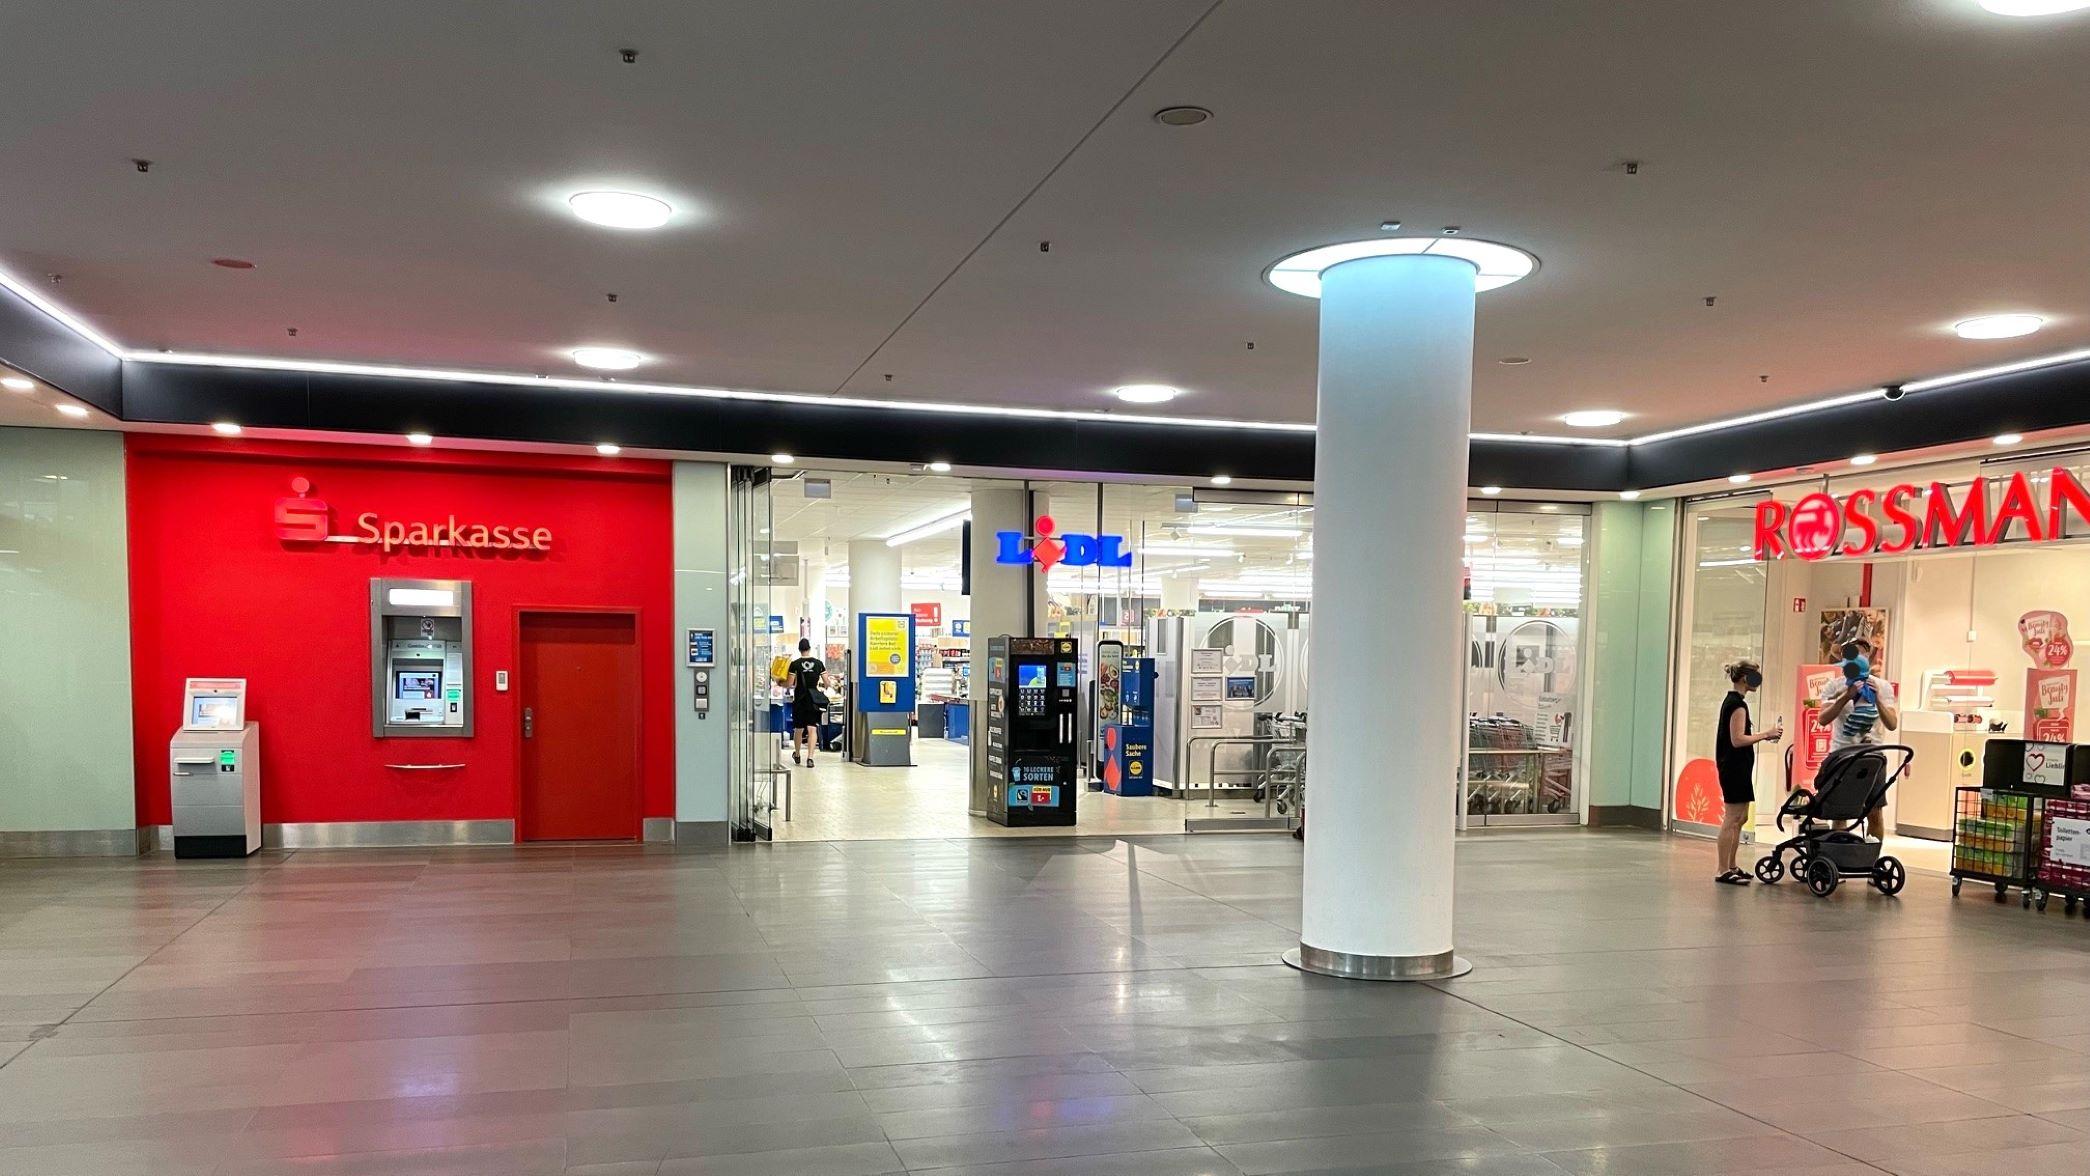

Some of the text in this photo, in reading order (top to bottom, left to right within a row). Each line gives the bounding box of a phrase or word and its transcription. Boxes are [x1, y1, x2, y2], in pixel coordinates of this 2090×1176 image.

[357, 512, 553, 552] Sparkasse
[2047, 644, 2068, 656] 24%
[1023, 773, 1054, 782] SORTEN
